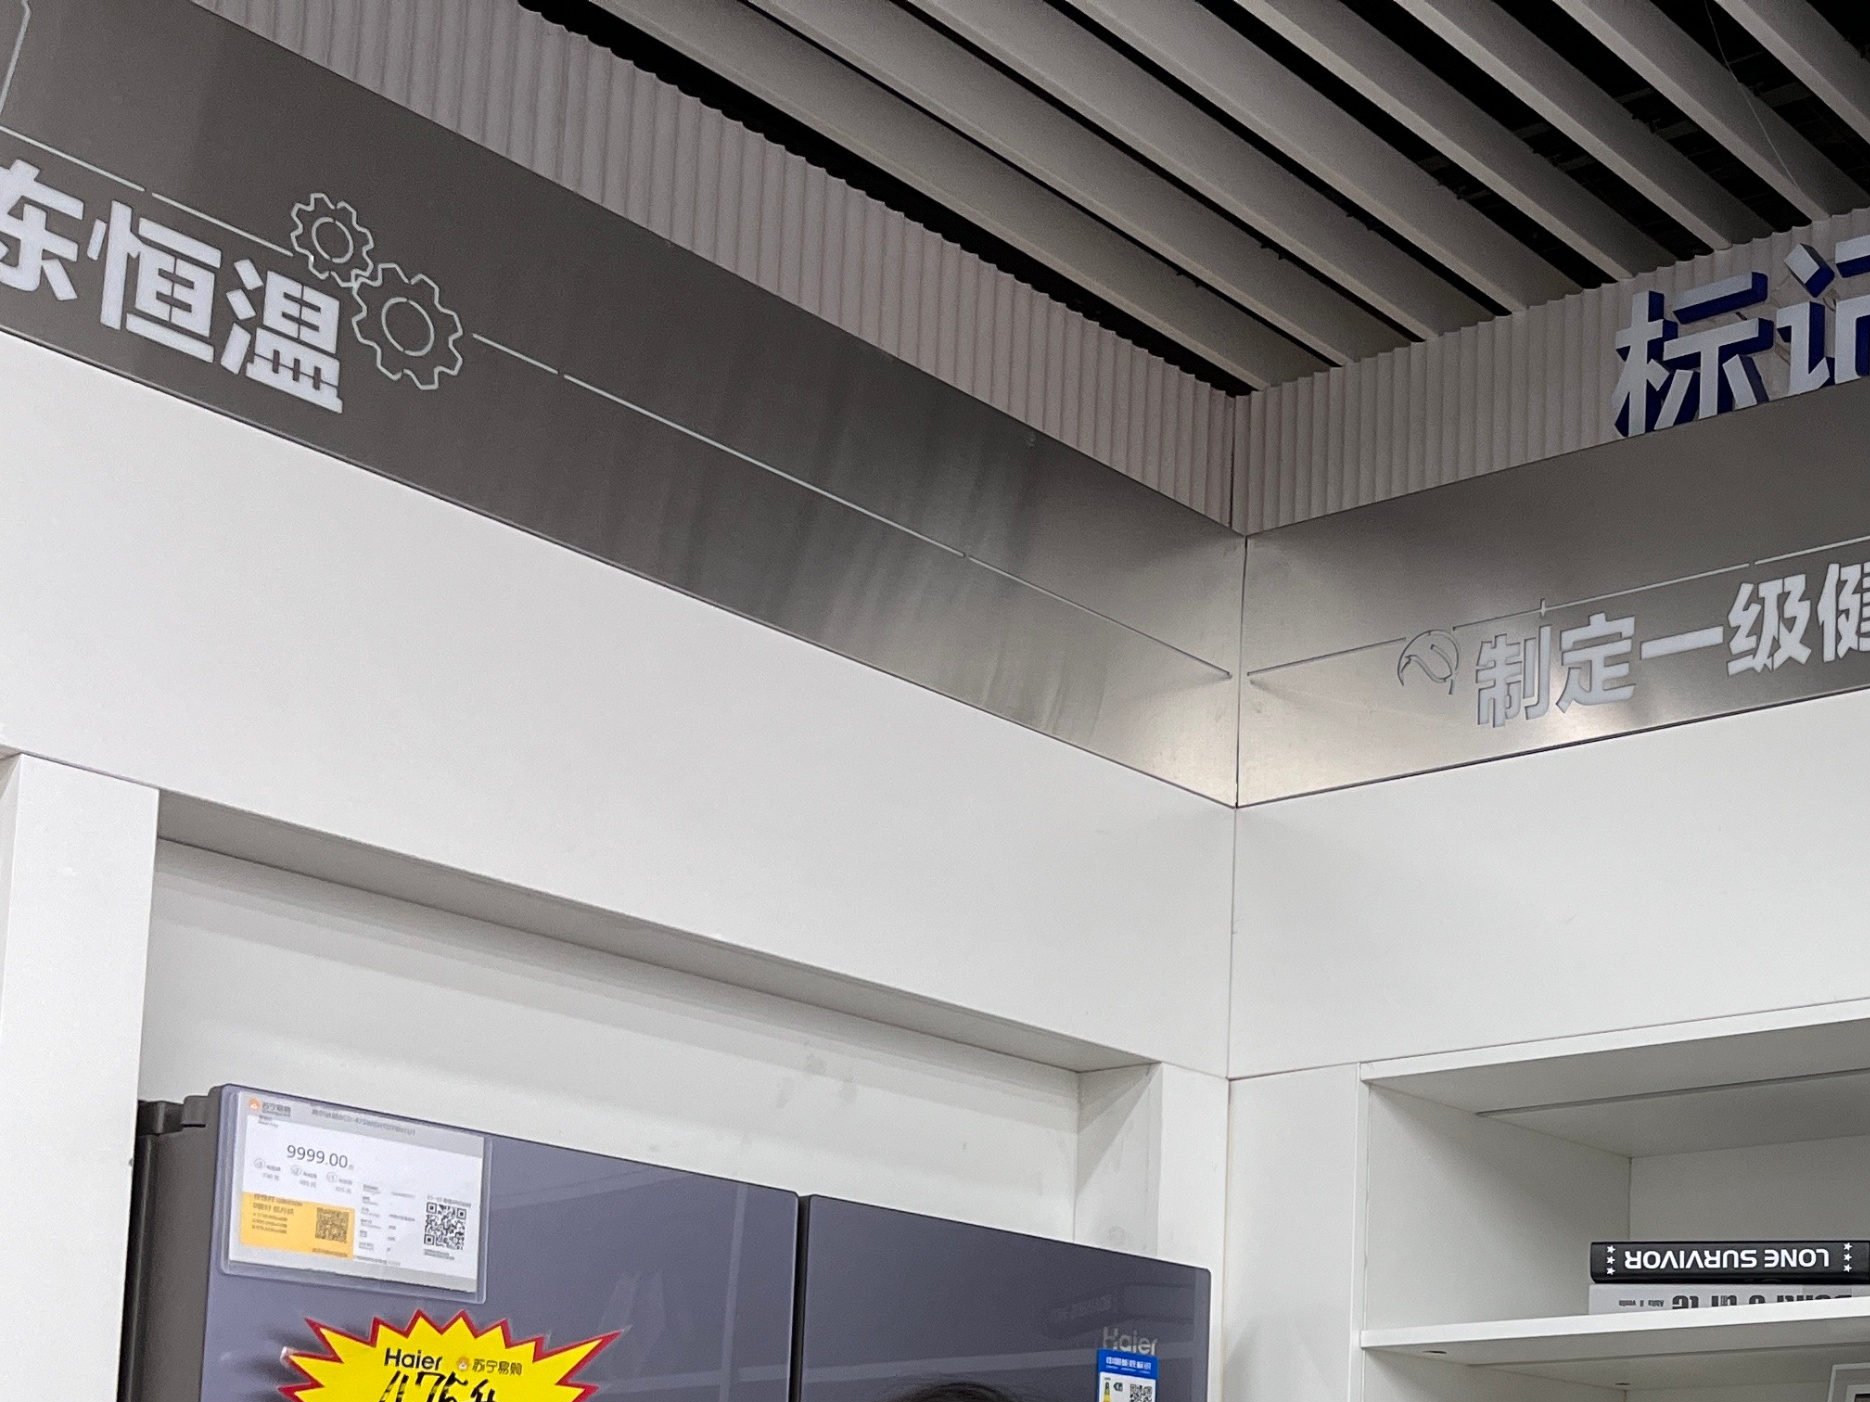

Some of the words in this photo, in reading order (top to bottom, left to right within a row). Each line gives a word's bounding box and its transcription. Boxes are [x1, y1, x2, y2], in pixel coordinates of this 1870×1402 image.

[1624, 1249, 1758, 1270] SURVIVOR
[1764, 1248, 1831, 1268] LONE
[1102, 1327, 1158, 1356] Haier
[384, 1348, 443, 1372] Haier
[472, 1358, 523, 1377] 苏宁易购
